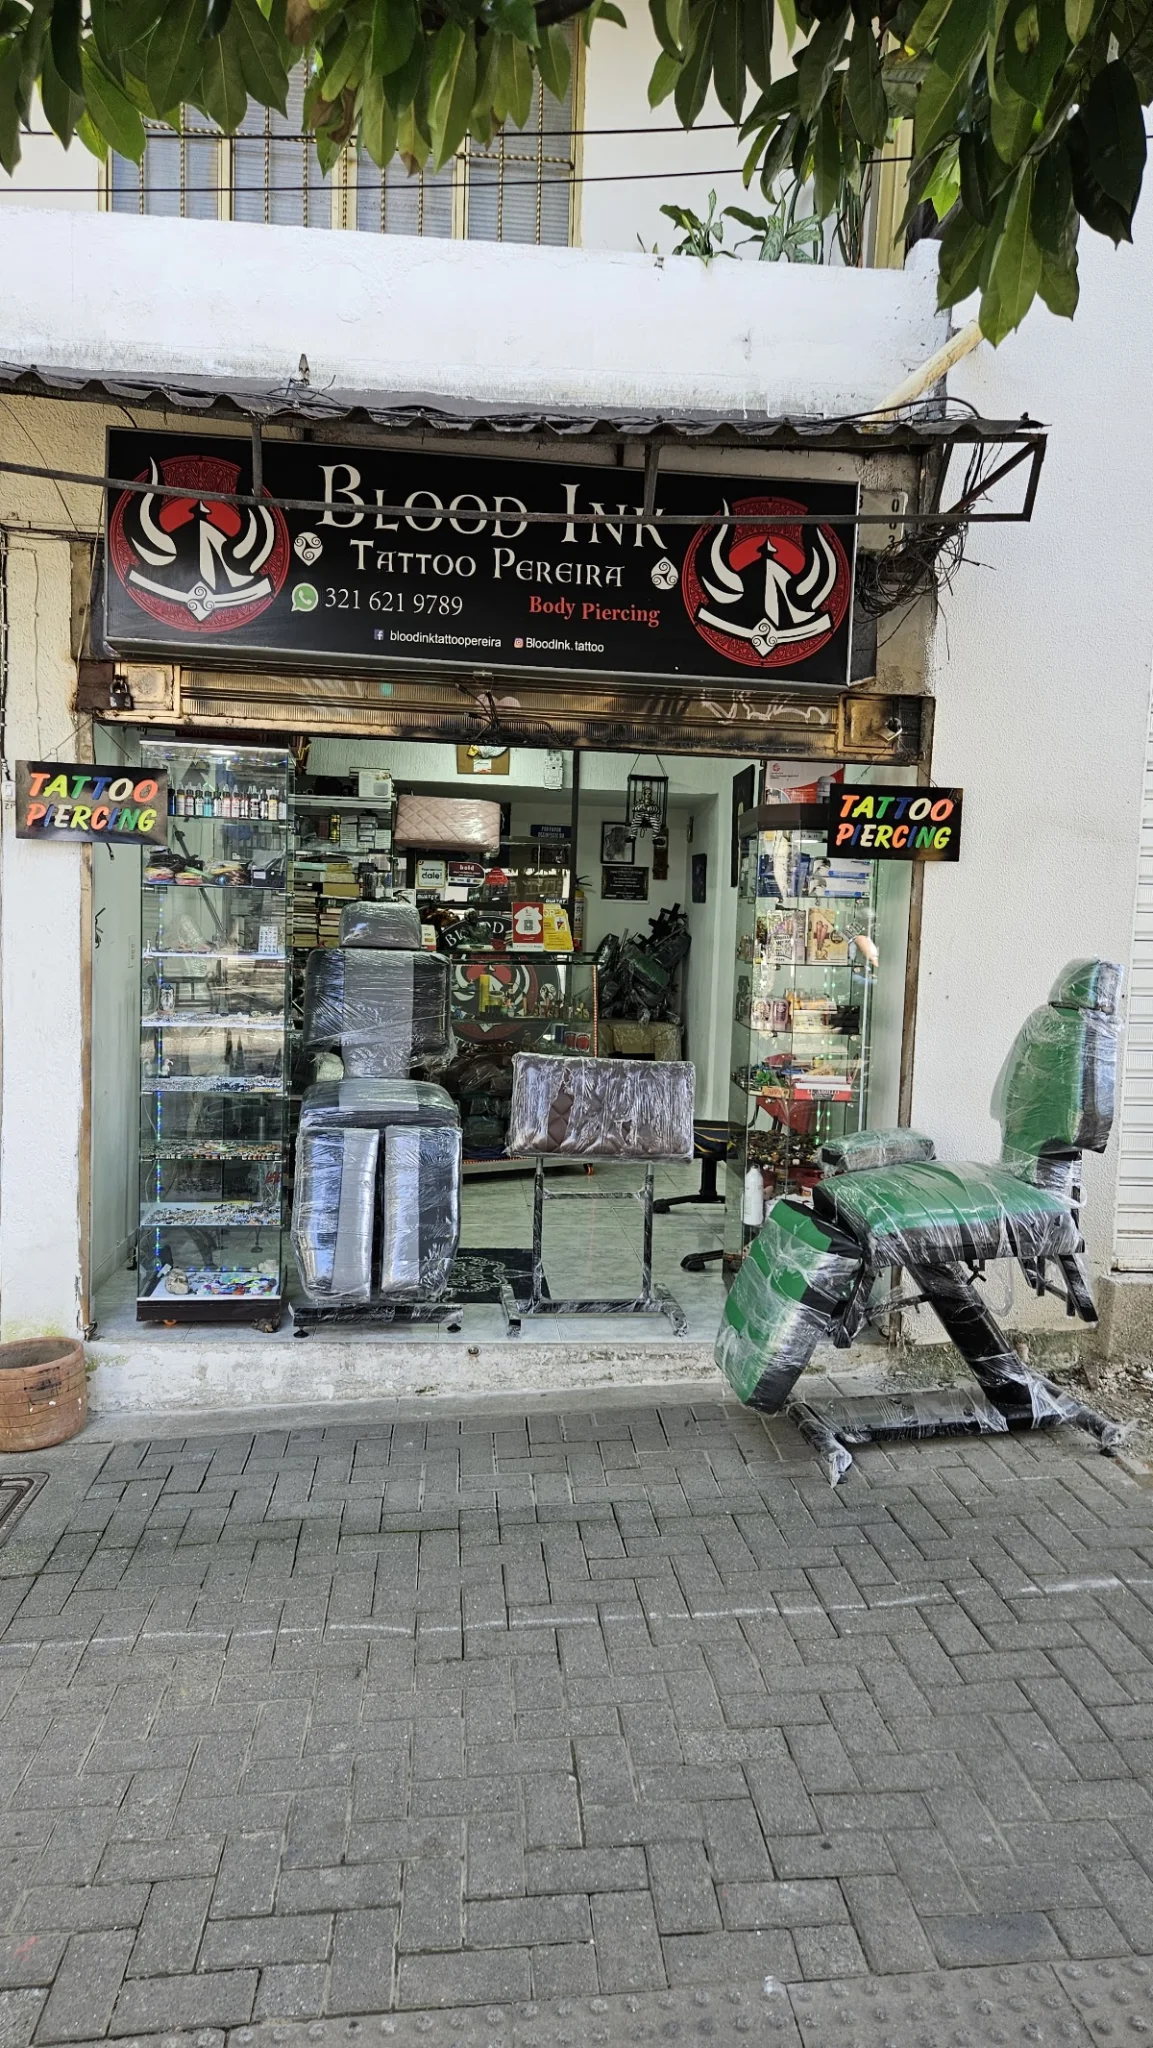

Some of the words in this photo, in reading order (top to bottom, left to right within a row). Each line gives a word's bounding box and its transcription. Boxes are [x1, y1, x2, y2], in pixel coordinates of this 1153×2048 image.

[315, 463, 528, 539] BLOOD
[560, 483, 669, 550] INK
[349, 538, 477, 578] TATTOO
[493, 547, 625, 588] PEREIRA
[324, 587, 361, 610] 321
[368, 591, 405, 613] 621
[412, 593, 464, 617] 9789
[528, 595, 576, 620] Body
[582, 602, 660, 627] Piercing
[389, 630, 502, 649] bloodinktattoopereira
[29, 772, 158, 803] TATTOO
[26, 803, 157, 833] PIERCING
[839, 794, 954, 822] TATTOO
[835, 823, 951, 850] PIERCING
